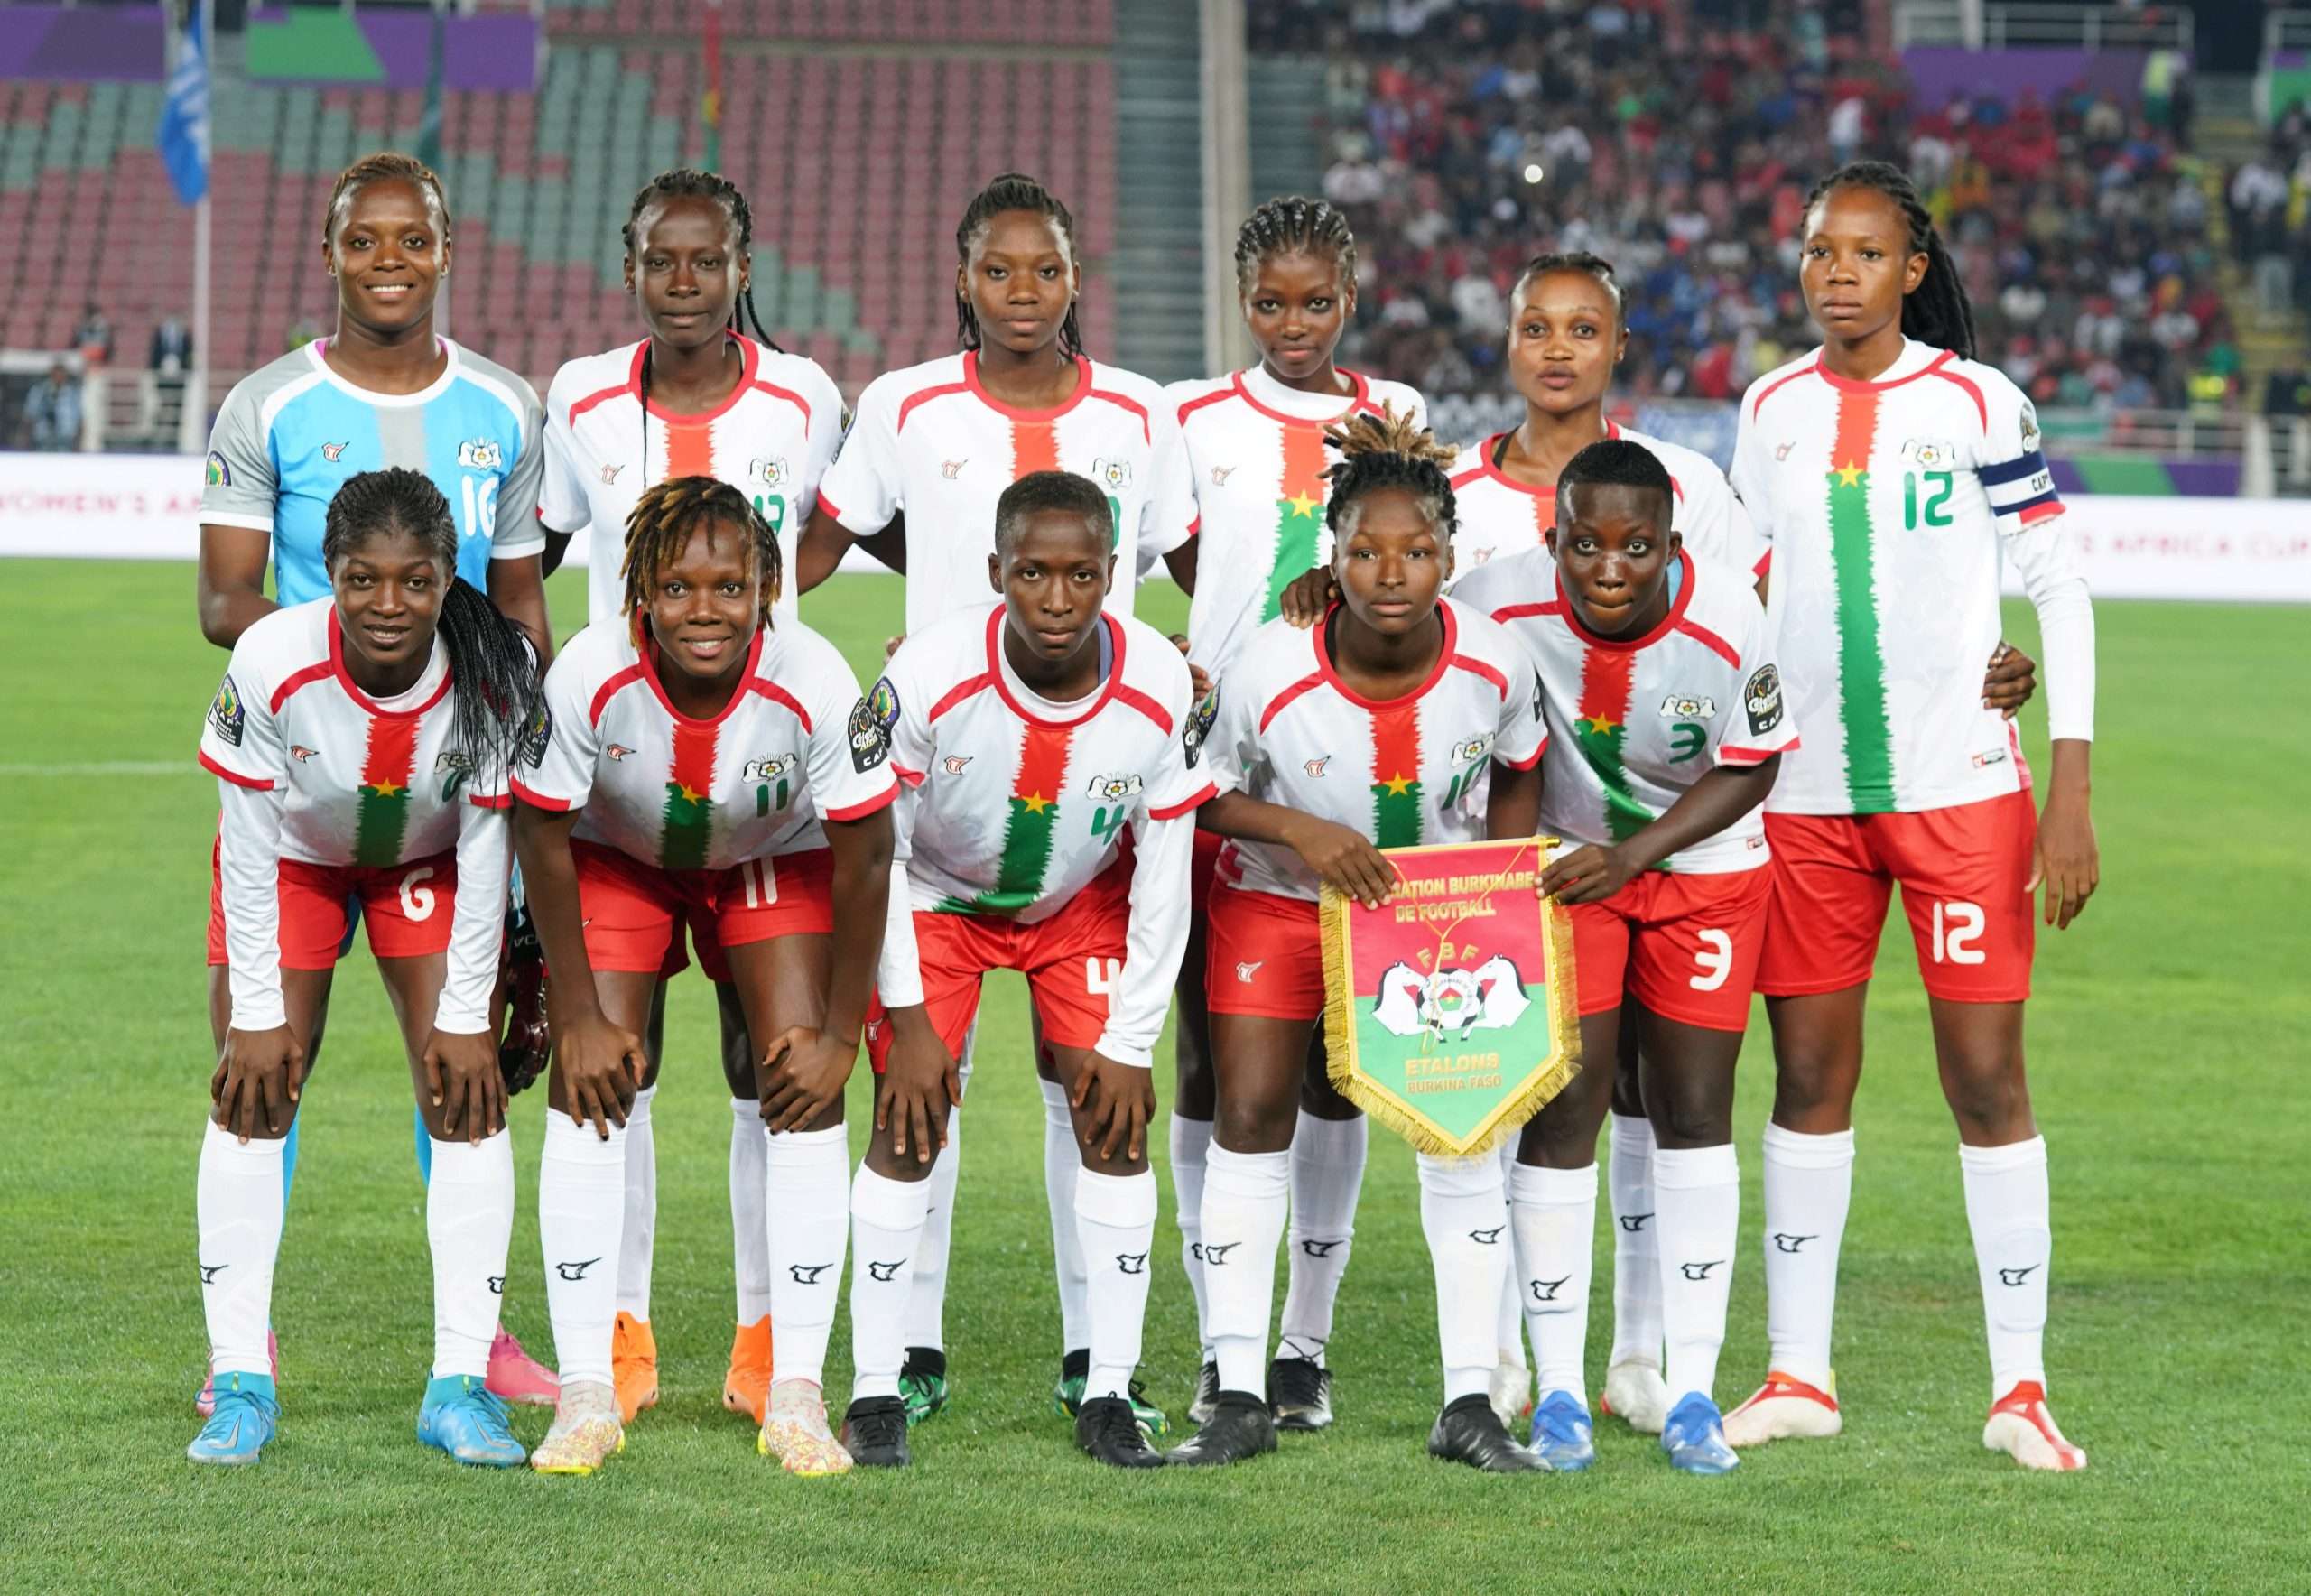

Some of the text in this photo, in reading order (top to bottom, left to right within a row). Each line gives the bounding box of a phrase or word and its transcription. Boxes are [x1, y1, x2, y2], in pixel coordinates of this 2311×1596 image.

[461, 475, 499, 538] 16
[1904, 470, 1954, 530] 12
[1669, 723, 1706, 765] 3
[756, 778, 788, 818] 11
[1091, 804, 1126, 845] 4
[399, 867, 435, 922] 6
[742, 857, 777, 909] 11
[1396, 898, 1496, 923] DE FOOTBALL
[1934, 902, 1985, 964] 12
[1086, 956, 1120, 1015] 4
[1690, 929, 1732, 991] 3
[1405, 1053, 1500, 1077] ETALONS
[1408, 1075, 1502, 1094] BURKINA FASO
